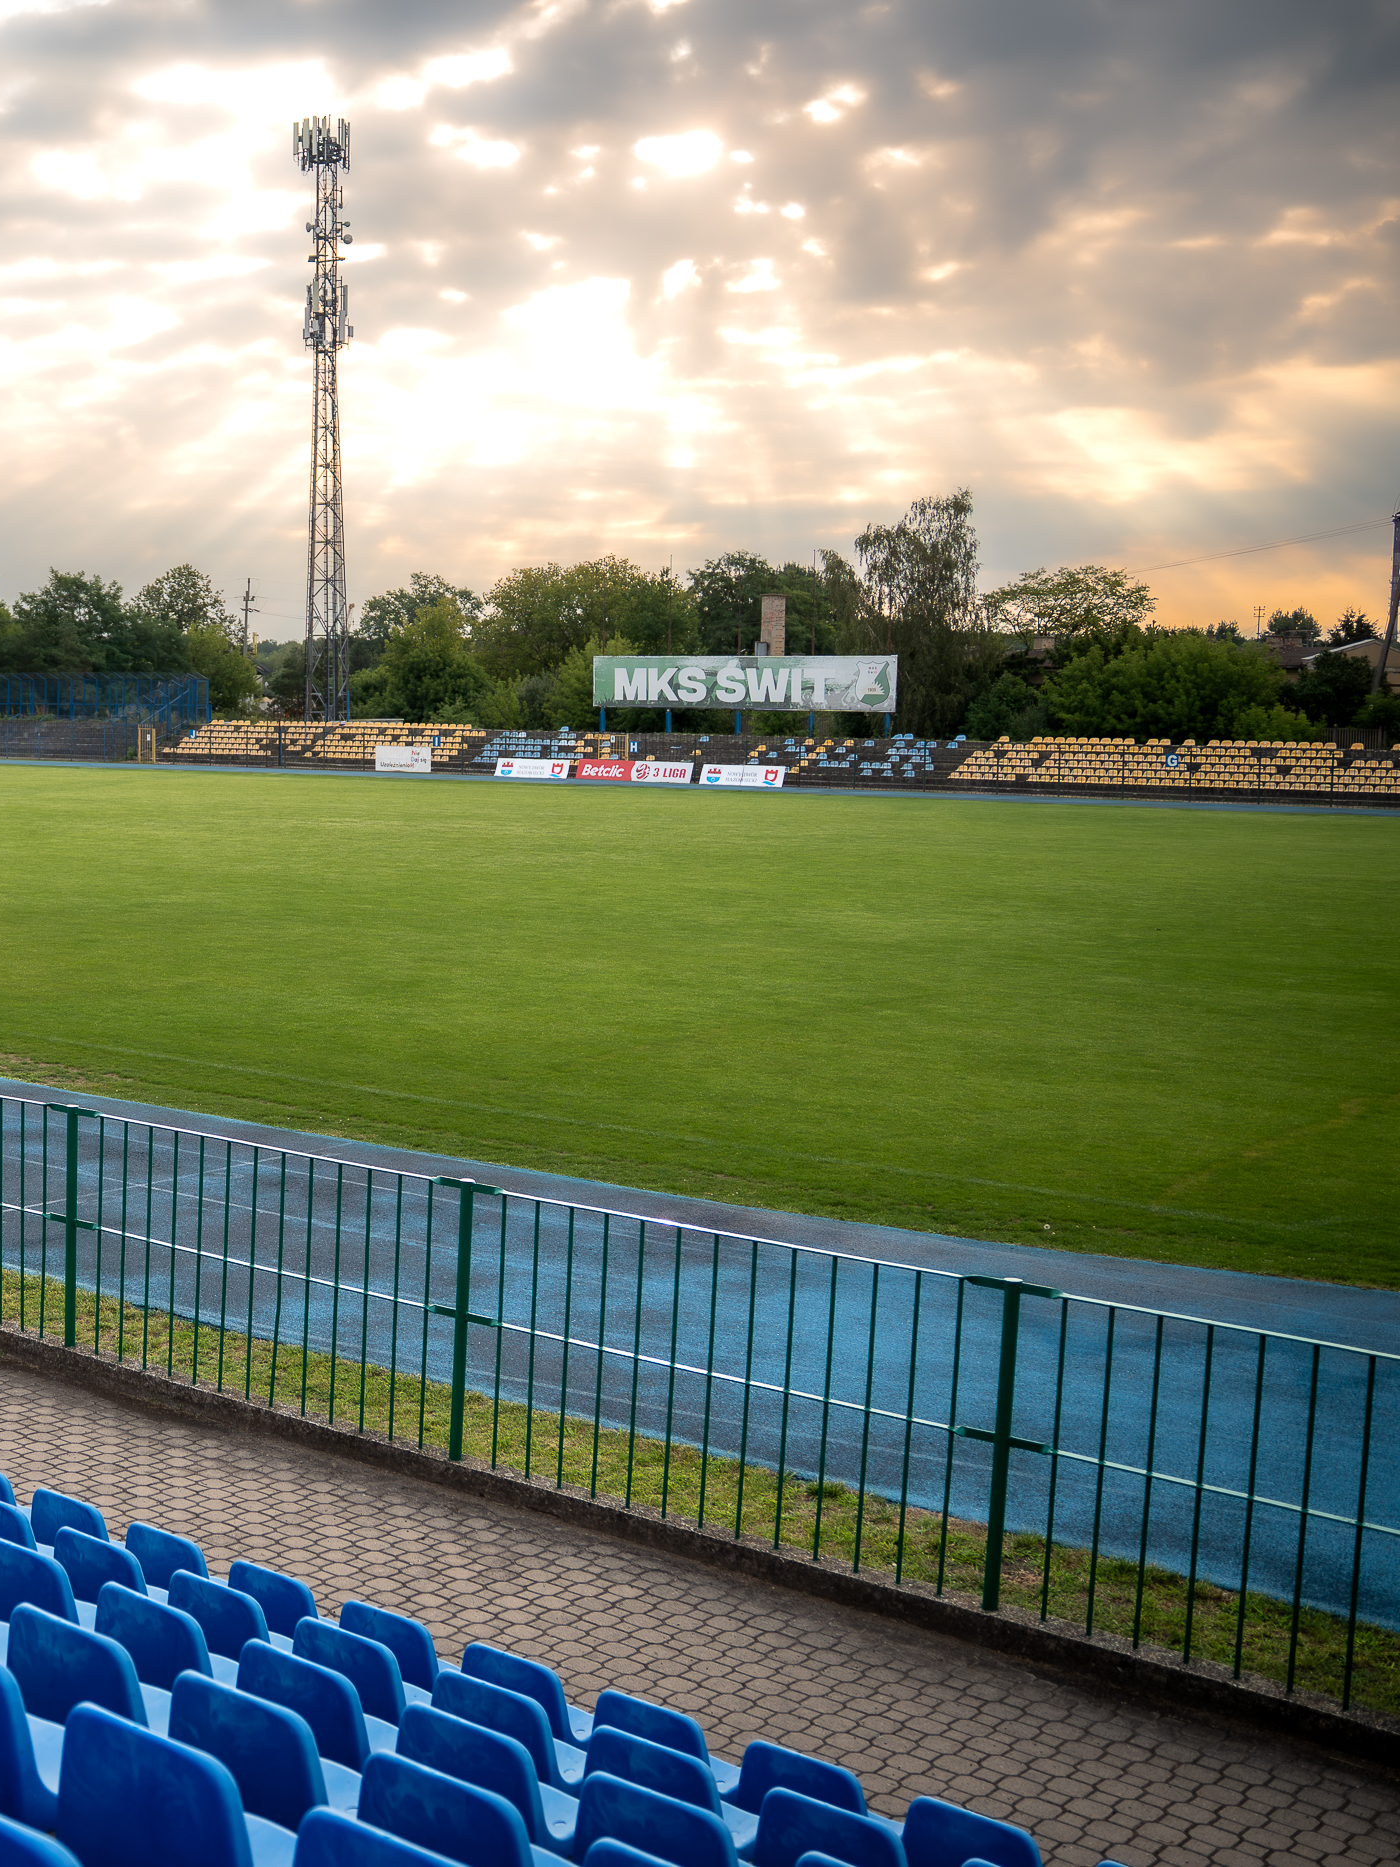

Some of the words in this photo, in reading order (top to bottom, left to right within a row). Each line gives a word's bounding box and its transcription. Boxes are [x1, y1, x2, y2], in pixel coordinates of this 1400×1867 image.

[614, 666, 707, 702] MKS
[715, 659, 836, 703] ŚWIT
[190, 729, 196, 738] J
[630, 741, 638, 752] H
[1167, 754, 1178, 767] G
[581, 764, 625, 777] Betclic
[653, 768, 660, 777] 3
[662, 768, 687, 778] LIGA
